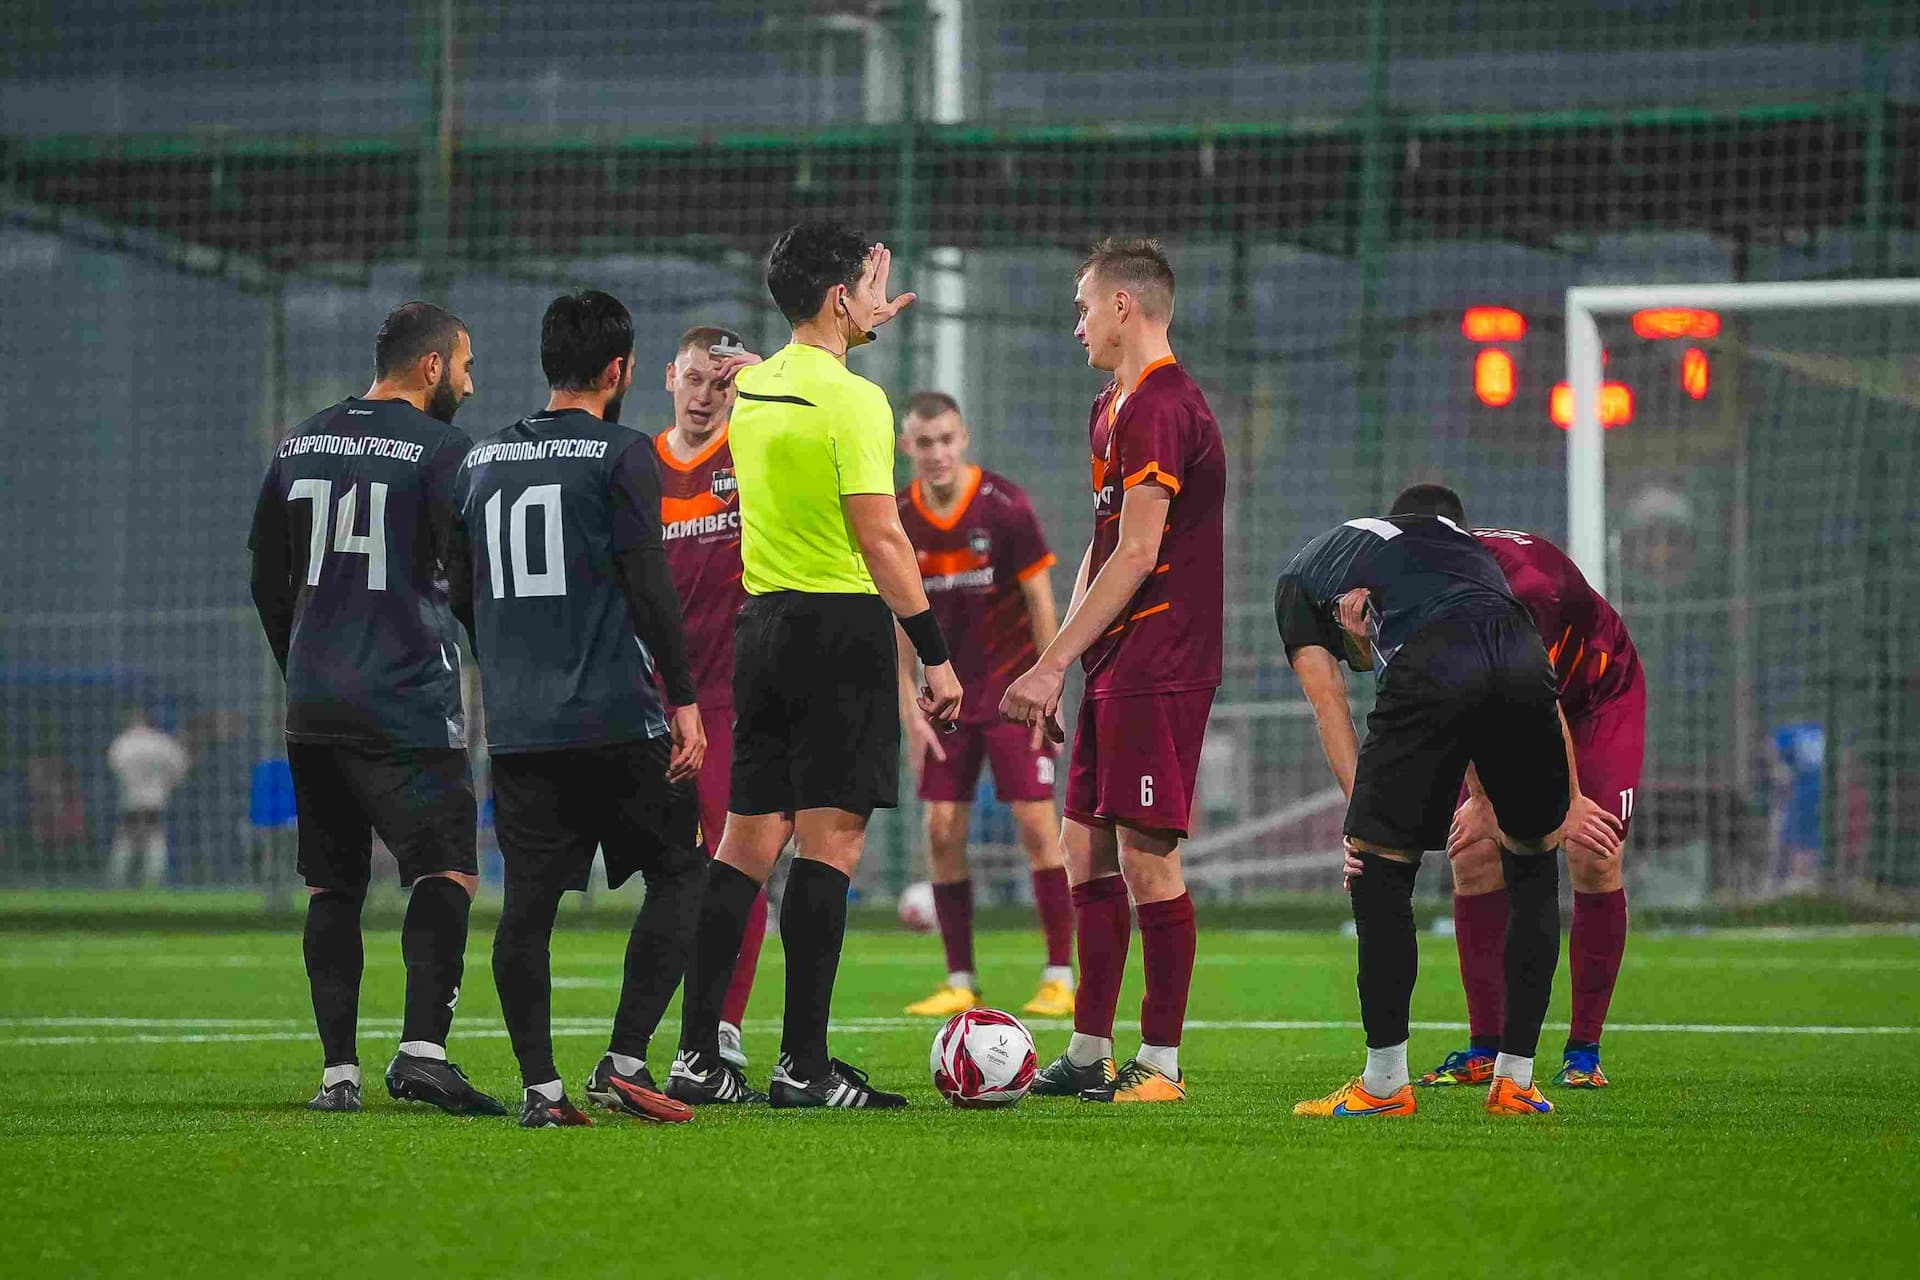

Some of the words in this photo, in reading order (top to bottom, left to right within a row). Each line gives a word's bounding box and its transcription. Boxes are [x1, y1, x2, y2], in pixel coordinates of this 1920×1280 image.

[280, 435, 424, 463] СТАВРОПОЛЬАГРОСОЮЗ
[467, 439, 608, 468] СТАВРОПОЛЬАГРОСОЮЗ
[485, 484, 567, 599] 10
[662, 511, 742, 541] ДИНВЕС
[1141, 775, 1153, 807] 6
[1620, 788, 1633, 821] 11
